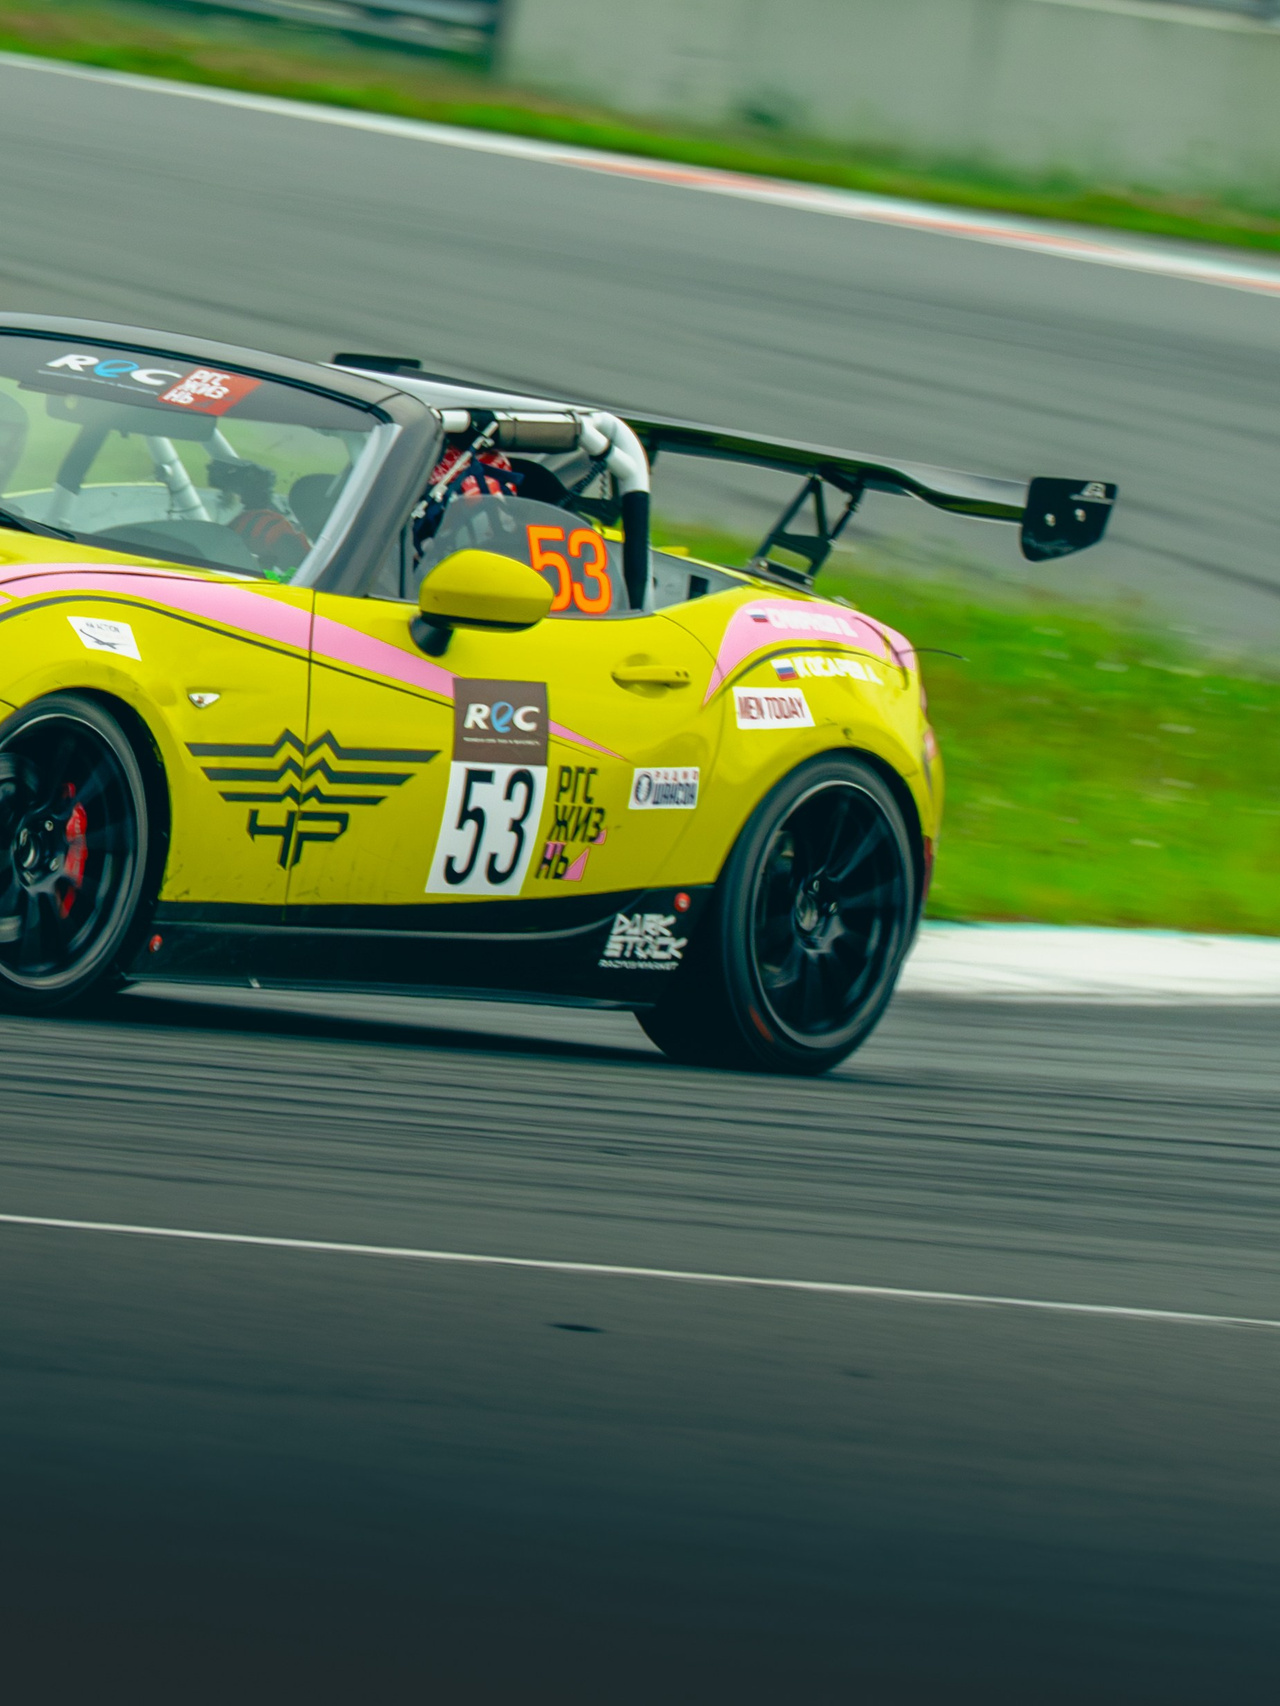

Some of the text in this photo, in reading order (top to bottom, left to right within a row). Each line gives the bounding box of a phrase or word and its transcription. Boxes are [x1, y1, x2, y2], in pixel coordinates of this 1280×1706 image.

[526, 524, 613, 614] 53
[763, 696, 806, 720] TODAY
[555, 765, 600, 805] РГС
[443, 768, 536, 886] 53
[547, 804, 606, 842] ЖИЗ
